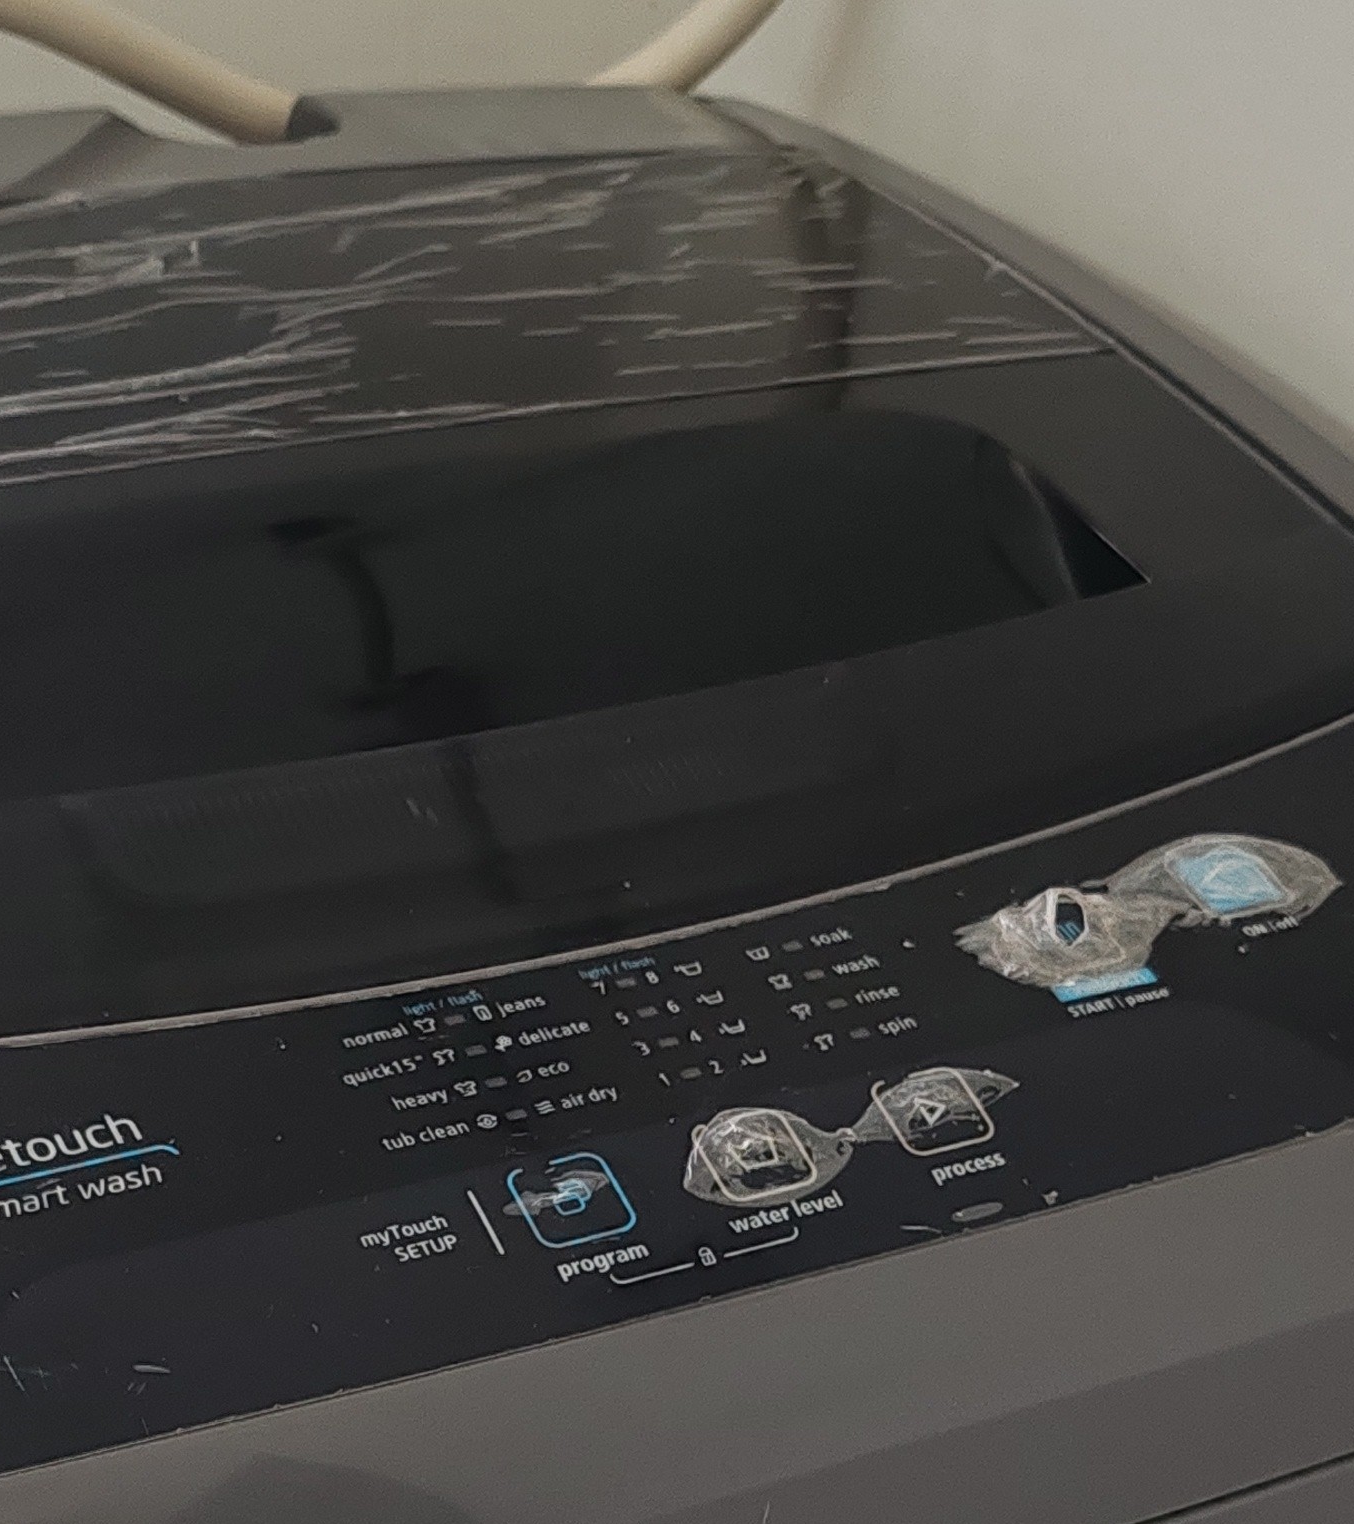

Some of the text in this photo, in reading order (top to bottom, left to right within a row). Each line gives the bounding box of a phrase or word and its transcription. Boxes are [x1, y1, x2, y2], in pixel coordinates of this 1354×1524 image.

[809, 927, 852, 948] soak
[645, 970, 660, 985] 8
[831, 953, 881, 976] wash
[854, 985, 901, 1005] rinse
[1067, 985, 1171, 1019] START pause
[342, 994, 546, 1049] normal jeans
[615, 999, 681, 1026] 5 6
[877, 1015, 918, 1037] spin
[517, 1019, 591, 1047] delicate
[631, 1040, 651, 1056] 3
[708, 1059, 724, 1074] 2
[391, 1060, 571, 1112] heavy eco
[382, 1084, 618, 1151] tub clean air dry
[77, 1163, 164, 1201] wash
[930, 1150, 1007, 1187] process
[728, 1188, 844, 1235] water level
[359, 1214, 449, 1249] myTouch
[395, 1233, 459, 1264] SETUP
[555, 1243, 650, 1283] program
